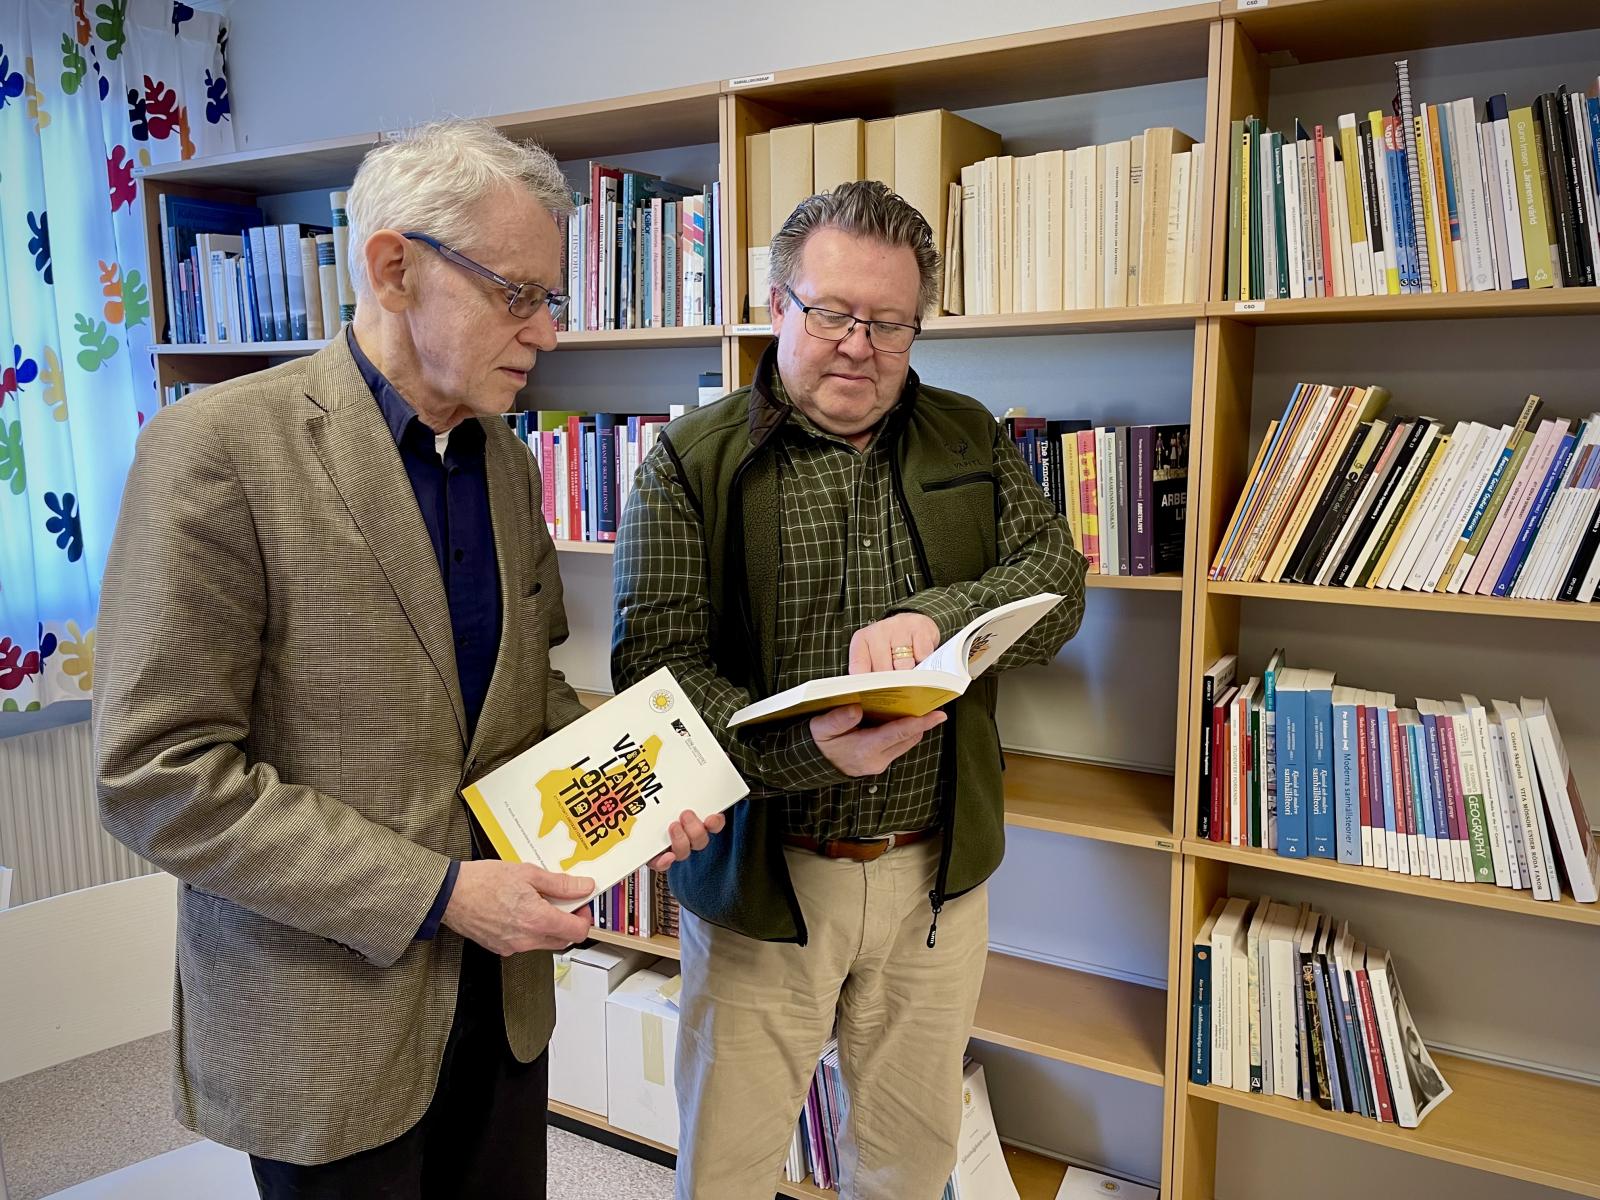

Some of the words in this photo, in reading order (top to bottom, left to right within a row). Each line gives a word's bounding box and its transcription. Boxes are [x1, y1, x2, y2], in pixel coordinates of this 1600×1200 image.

[1517, 122, 1528, 142] Gunn
[1519, 144, 1531, 166] Imsen
[1522, 170, 1535, 204] Lärarens
[1526, 206, 1538, 224] värld
[1521, 398, 1535, 420] FISHER
[1040, 441, 1049, 456] The
[1493, 455, 1510, 477] Amazing
[1041, 458, 1051, 497] Managed
[1486, 476, 1499, 492] Social
[1336, 480, 1352, 501] Allmän
[1476, 491, 1491, 510] Studies
[1330, 499, 1342, 512] del
[1466, 509, 1482, 532] Activities
[570, 756, 590, 770] I
[612, 733, 663, 805] VÄRM-
[1343, 754, 1352, 786] Moderna
[1514, 753, 1524, 779] Skoglund
[597, 756, 646, 816] LAND
[1284, 768, 1293, 815] samhällsteori
[1313, 768, 1321, 815] samhällsteori
[1520, 788, 1528, 802] VITA
[558, 778, 610, 847] TIDER
[578, 769, 630, 837] OROS-
[1344, 788, 1353, 843] samhällsteorier
[1467, 795, 1487, 858] GEOGRAPHY
[1522, 804, 1533, 828] MÖSSOR
[1527, 830, 1536, 850] UNDER
[1530, 852, 1539, 868] RÖDA
[1534, 870, 1543, 890] FANOR
